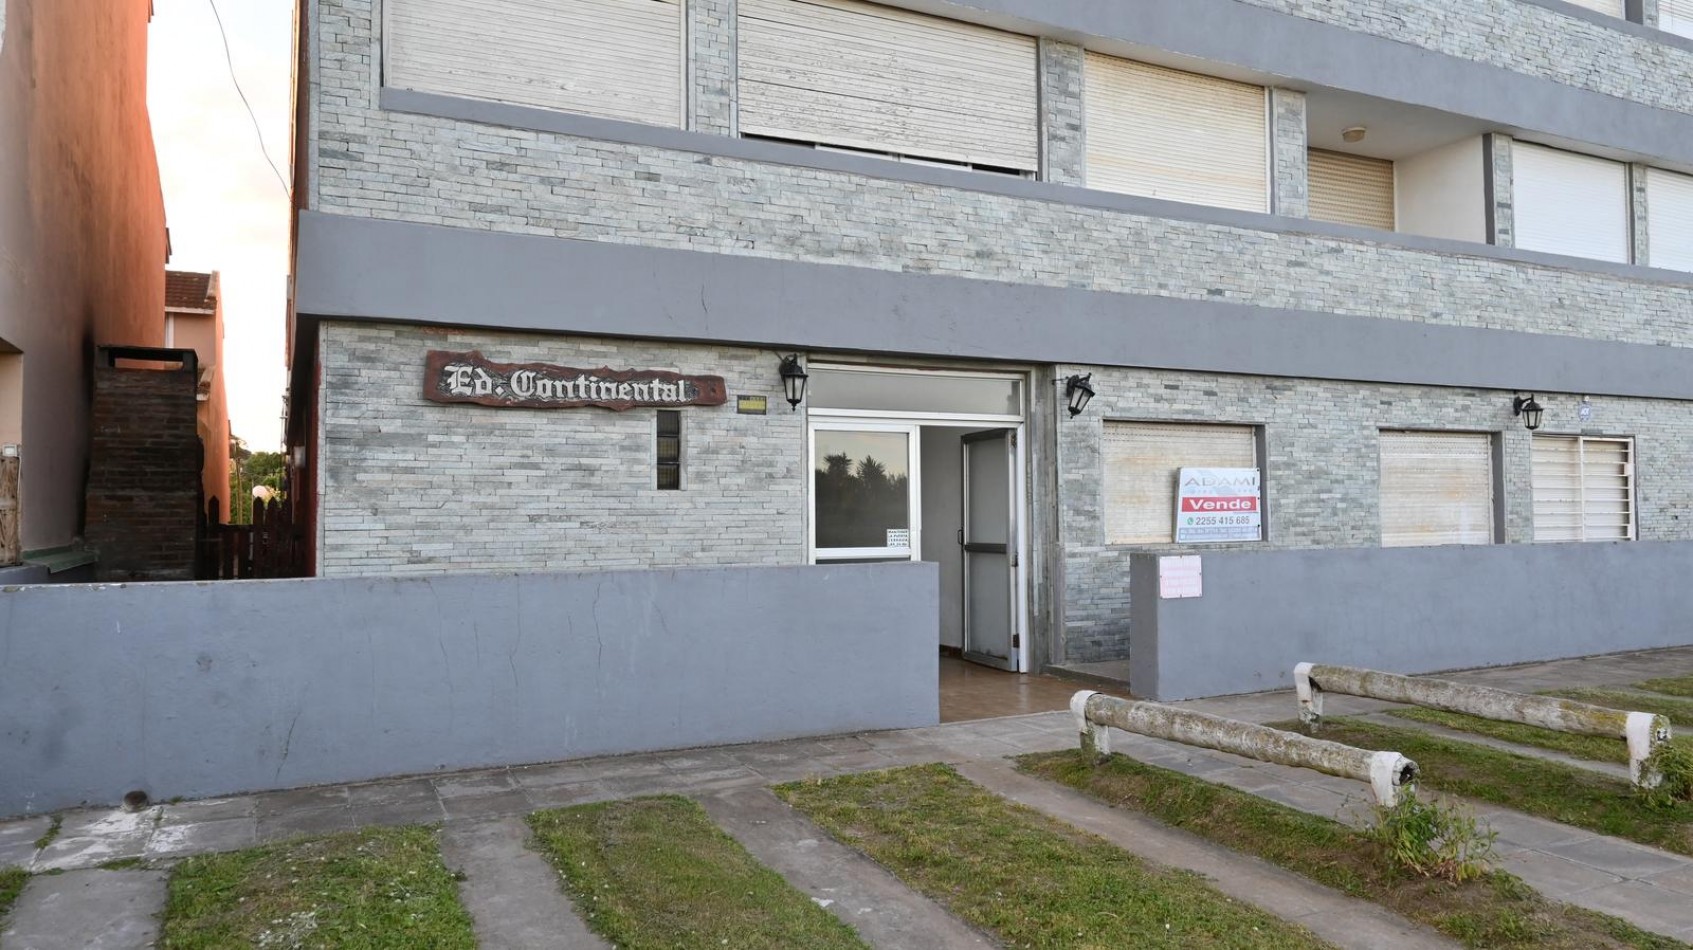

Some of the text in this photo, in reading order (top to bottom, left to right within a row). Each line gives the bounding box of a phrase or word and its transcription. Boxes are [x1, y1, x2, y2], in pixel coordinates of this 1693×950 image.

[444, 364, 688, 402] Ed. Continental
[1184, 477, 1255, 486] ADAMI
[1189, 498, 1251, 510] Vende
[1195, 517, 1216, 525] 2255
[1218, 516, 1234, 525] 415
